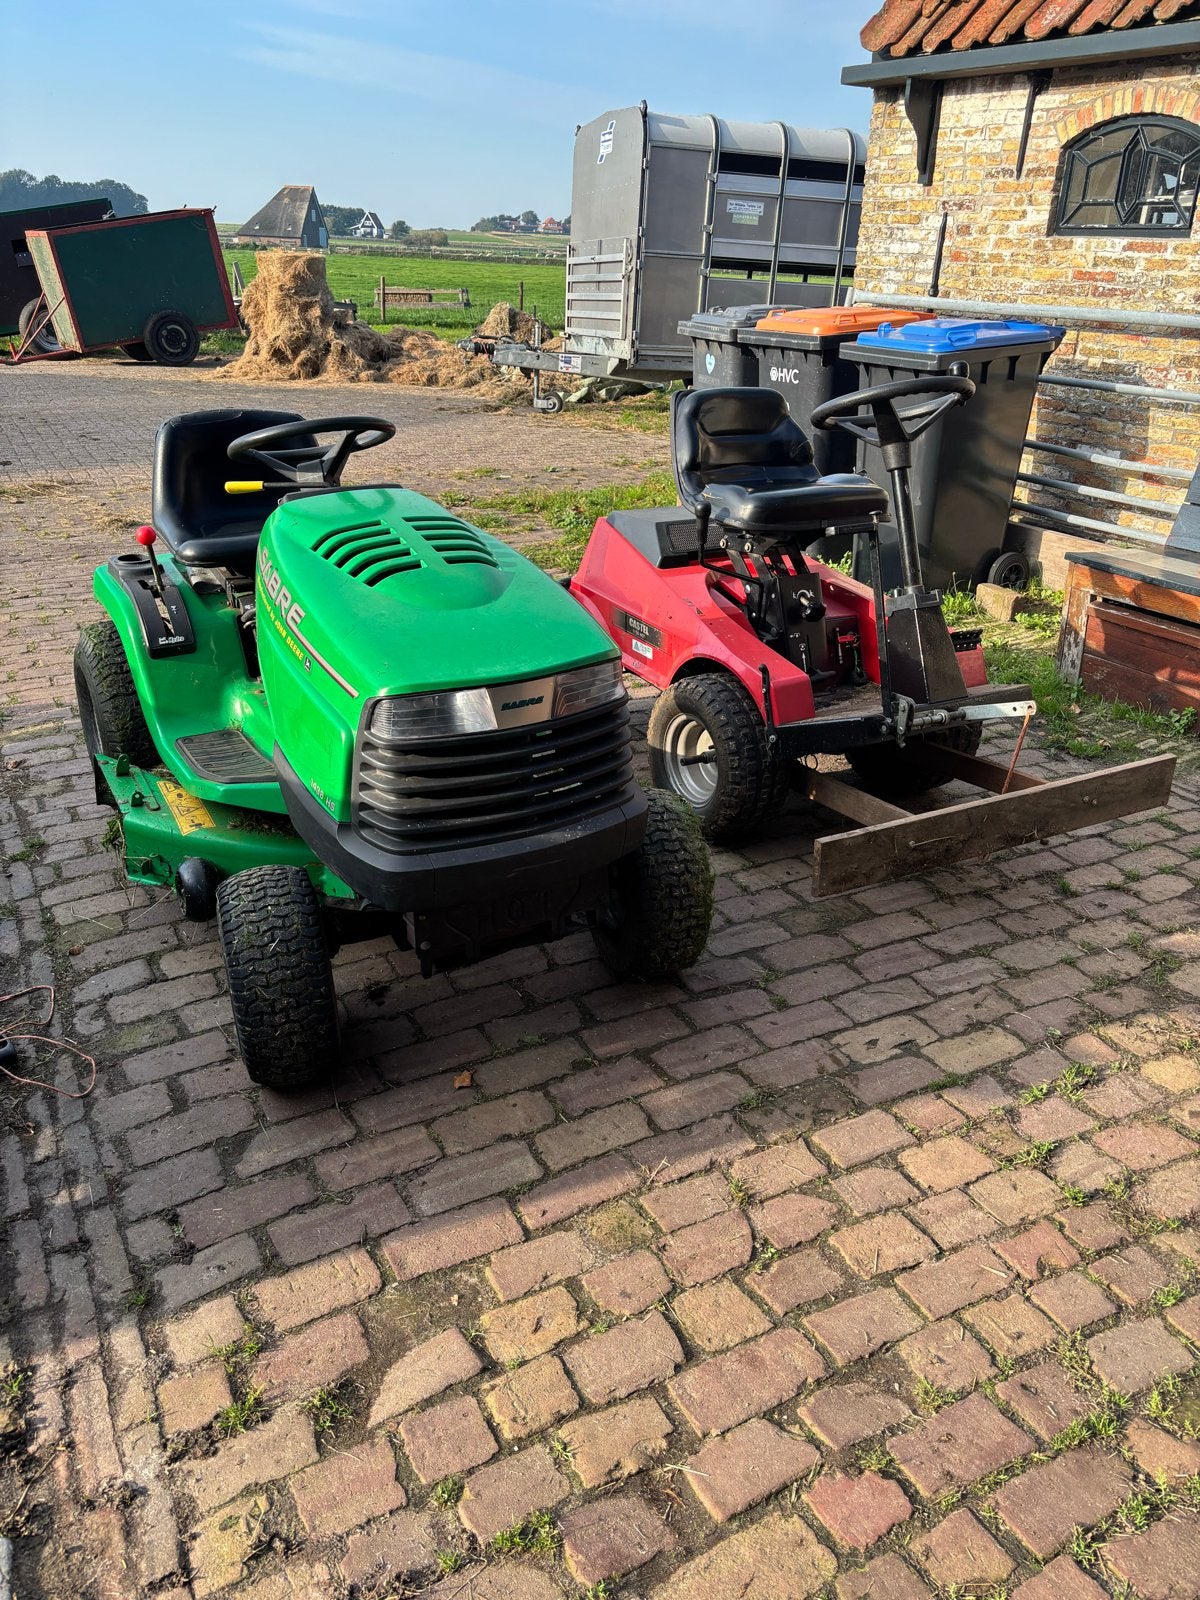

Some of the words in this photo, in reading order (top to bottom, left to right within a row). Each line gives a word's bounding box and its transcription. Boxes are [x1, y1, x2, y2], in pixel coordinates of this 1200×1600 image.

[778, 367, 800, 384] HVC
[257, 546, 306, 626] SABRE
[629, 617, 650, 636] CASTEL
[275, 620, 287, 638] JOHN
[286, 636, 304, 660] DEERE
[501, 695, 545, 711] SABRE
